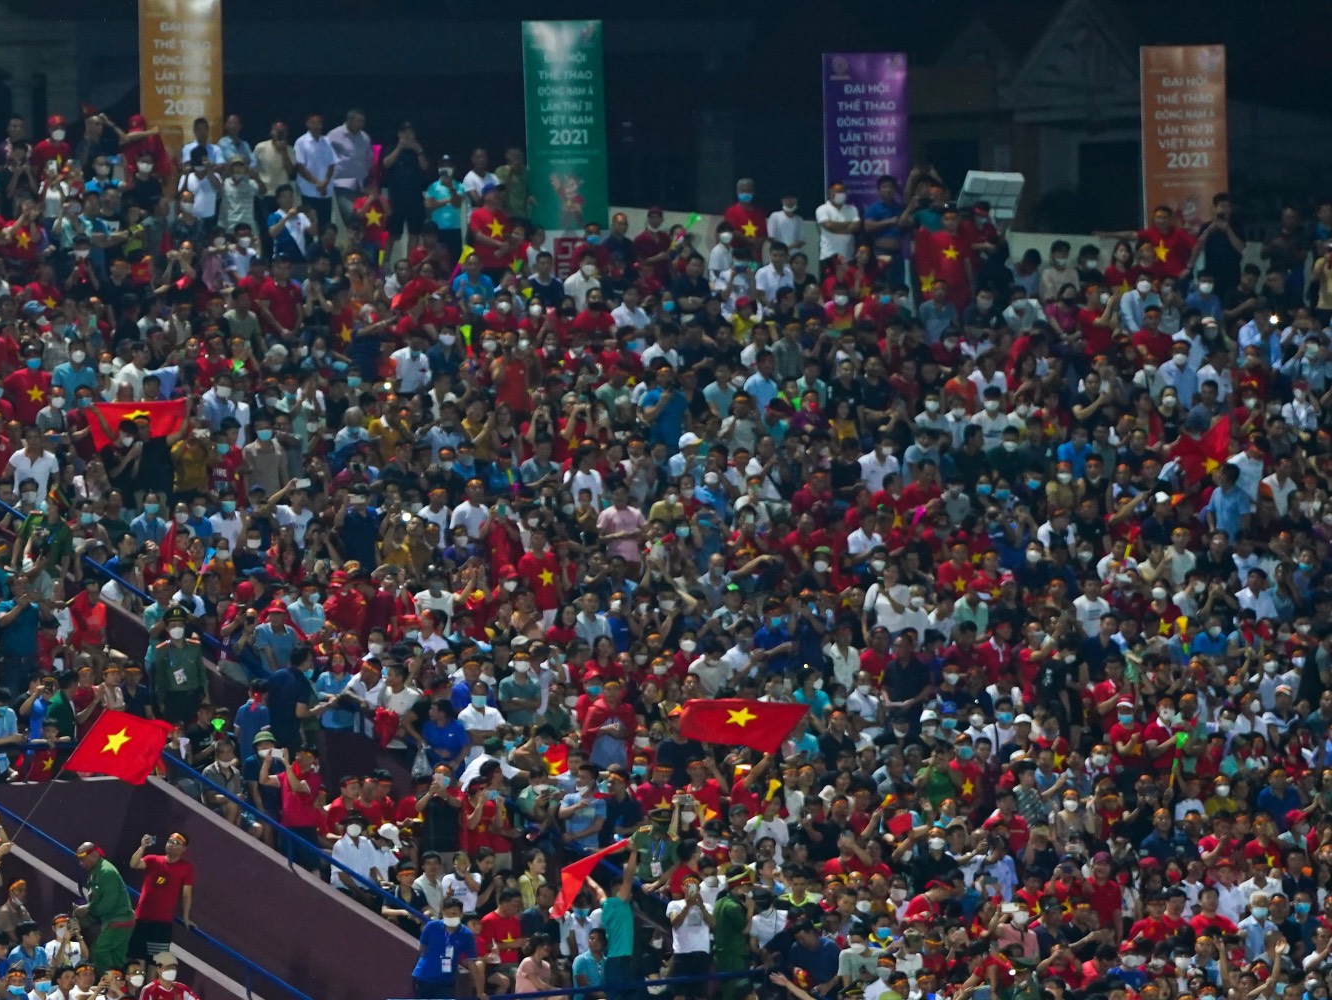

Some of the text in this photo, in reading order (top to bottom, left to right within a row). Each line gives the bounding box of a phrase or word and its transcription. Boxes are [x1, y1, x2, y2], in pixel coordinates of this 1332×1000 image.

[564, 70, 593, 79] THAO
[864, 101, 896, 111] THAO
[569, 115, 594, 124] NAM
[549, 129, 589, 145] 2021
[869, 145, 897, 155] NAM
[1166, 152, 1209, 169] 2021
[848, 159, 891, 176] 2021
